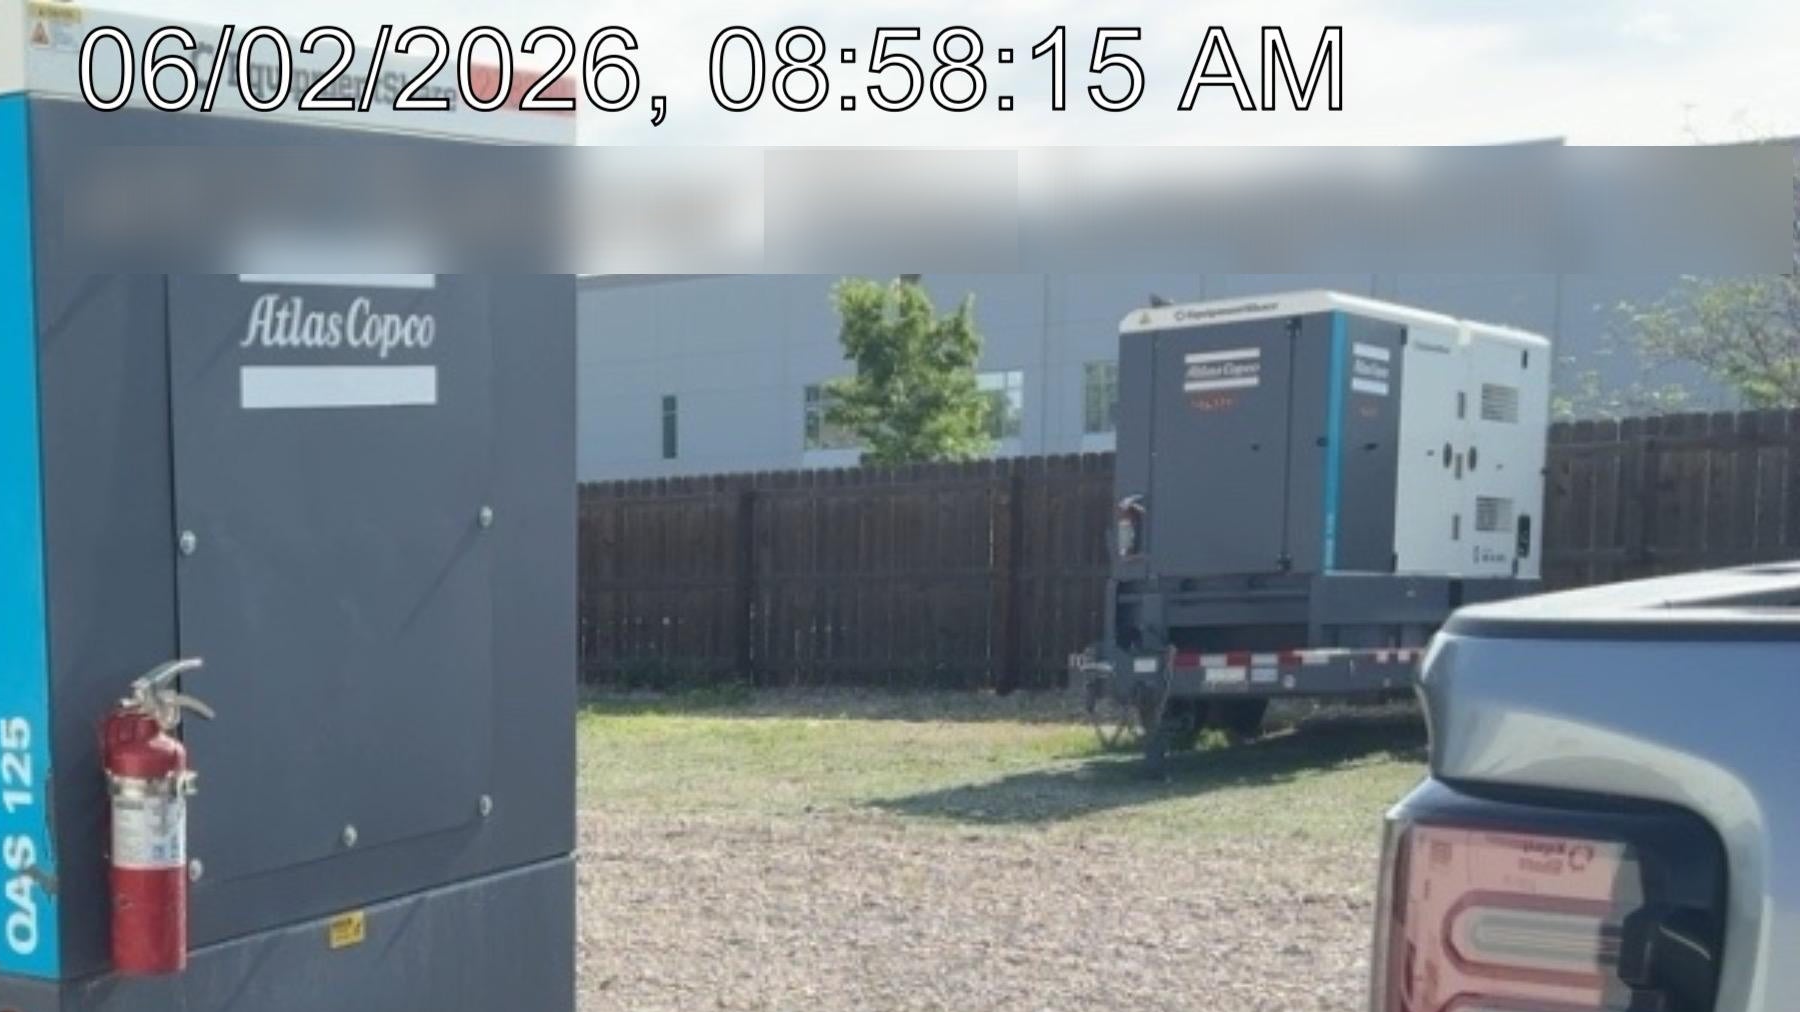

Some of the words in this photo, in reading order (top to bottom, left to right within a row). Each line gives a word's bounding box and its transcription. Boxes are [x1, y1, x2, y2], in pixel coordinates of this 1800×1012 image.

[239, 293, 343, 348] Atlas
[347, 295, 436, 359] Copco
[0, 715, 34, 814] 125
